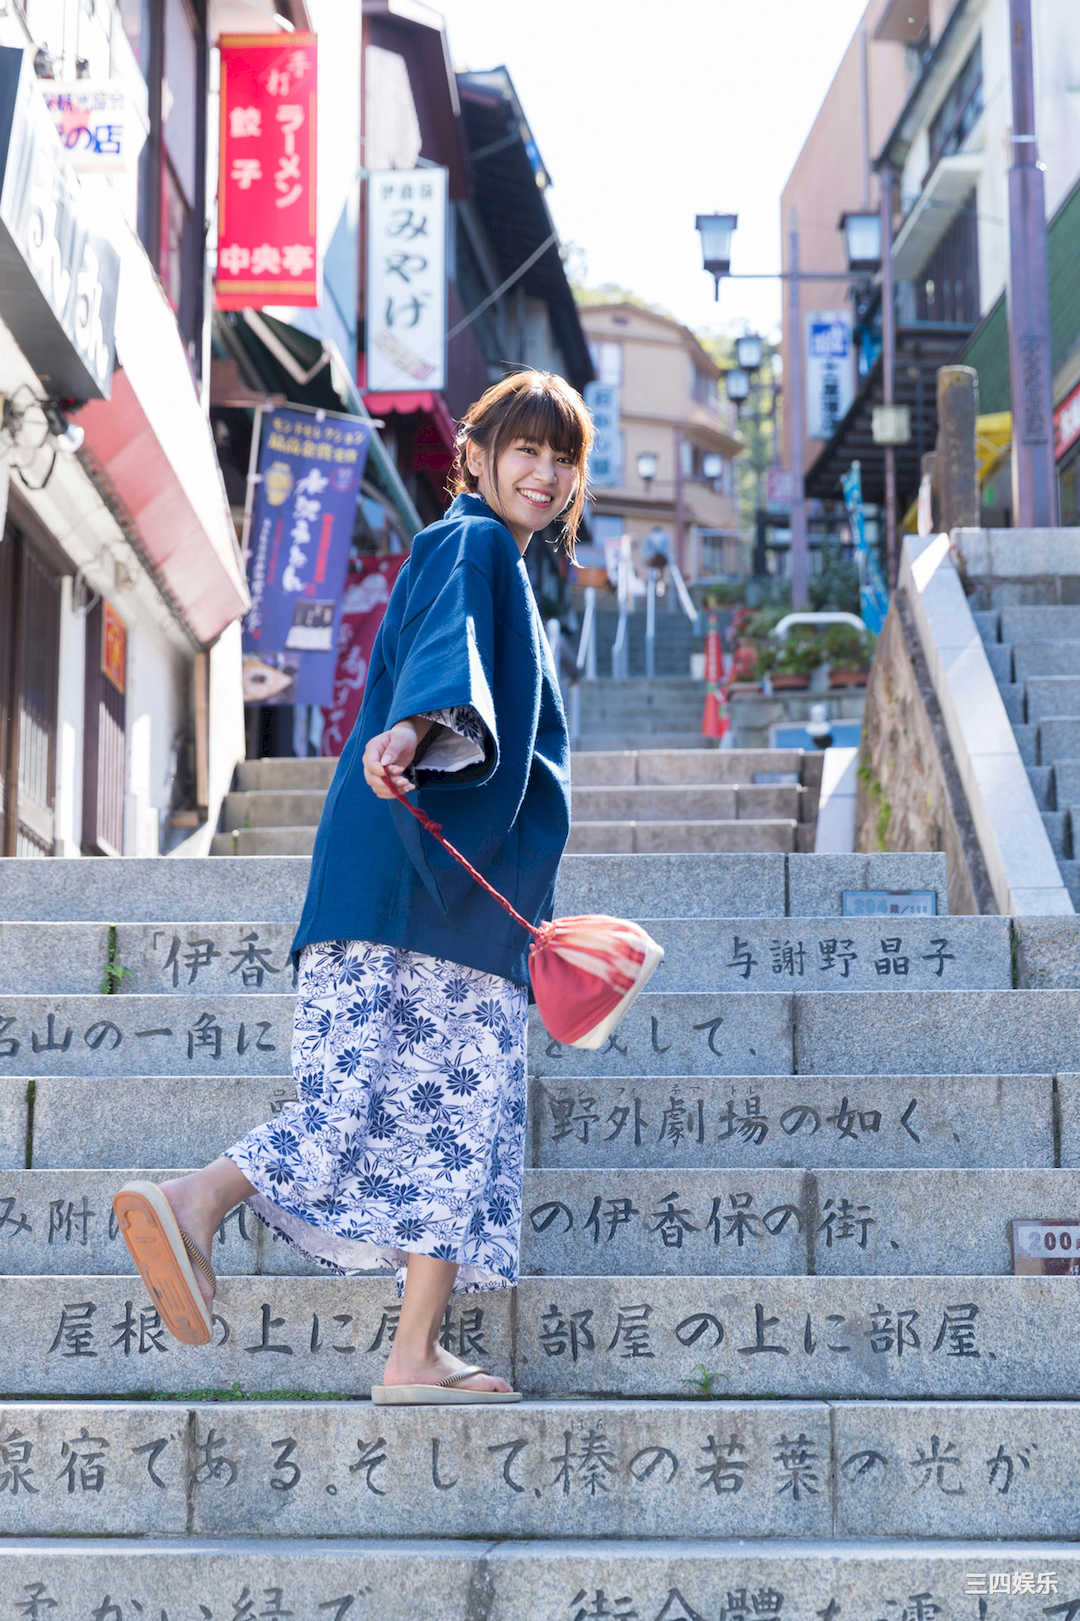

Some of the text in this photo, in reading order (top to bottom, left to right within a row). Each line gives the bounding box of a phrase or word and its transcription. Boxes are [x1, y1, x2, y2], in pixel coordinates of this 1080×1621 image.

[55, 124, 123, 154] の店
[229, 106, 262, 190] 餃子
[276, 104, 304, 208] ラーメン
[220, 243, 315, 276] 中央亭
[385, 208, 432, 328] みやげ
[726, 936, 955, 979] 与謝野晶子
[545, 1014, 757, 1059] して、
